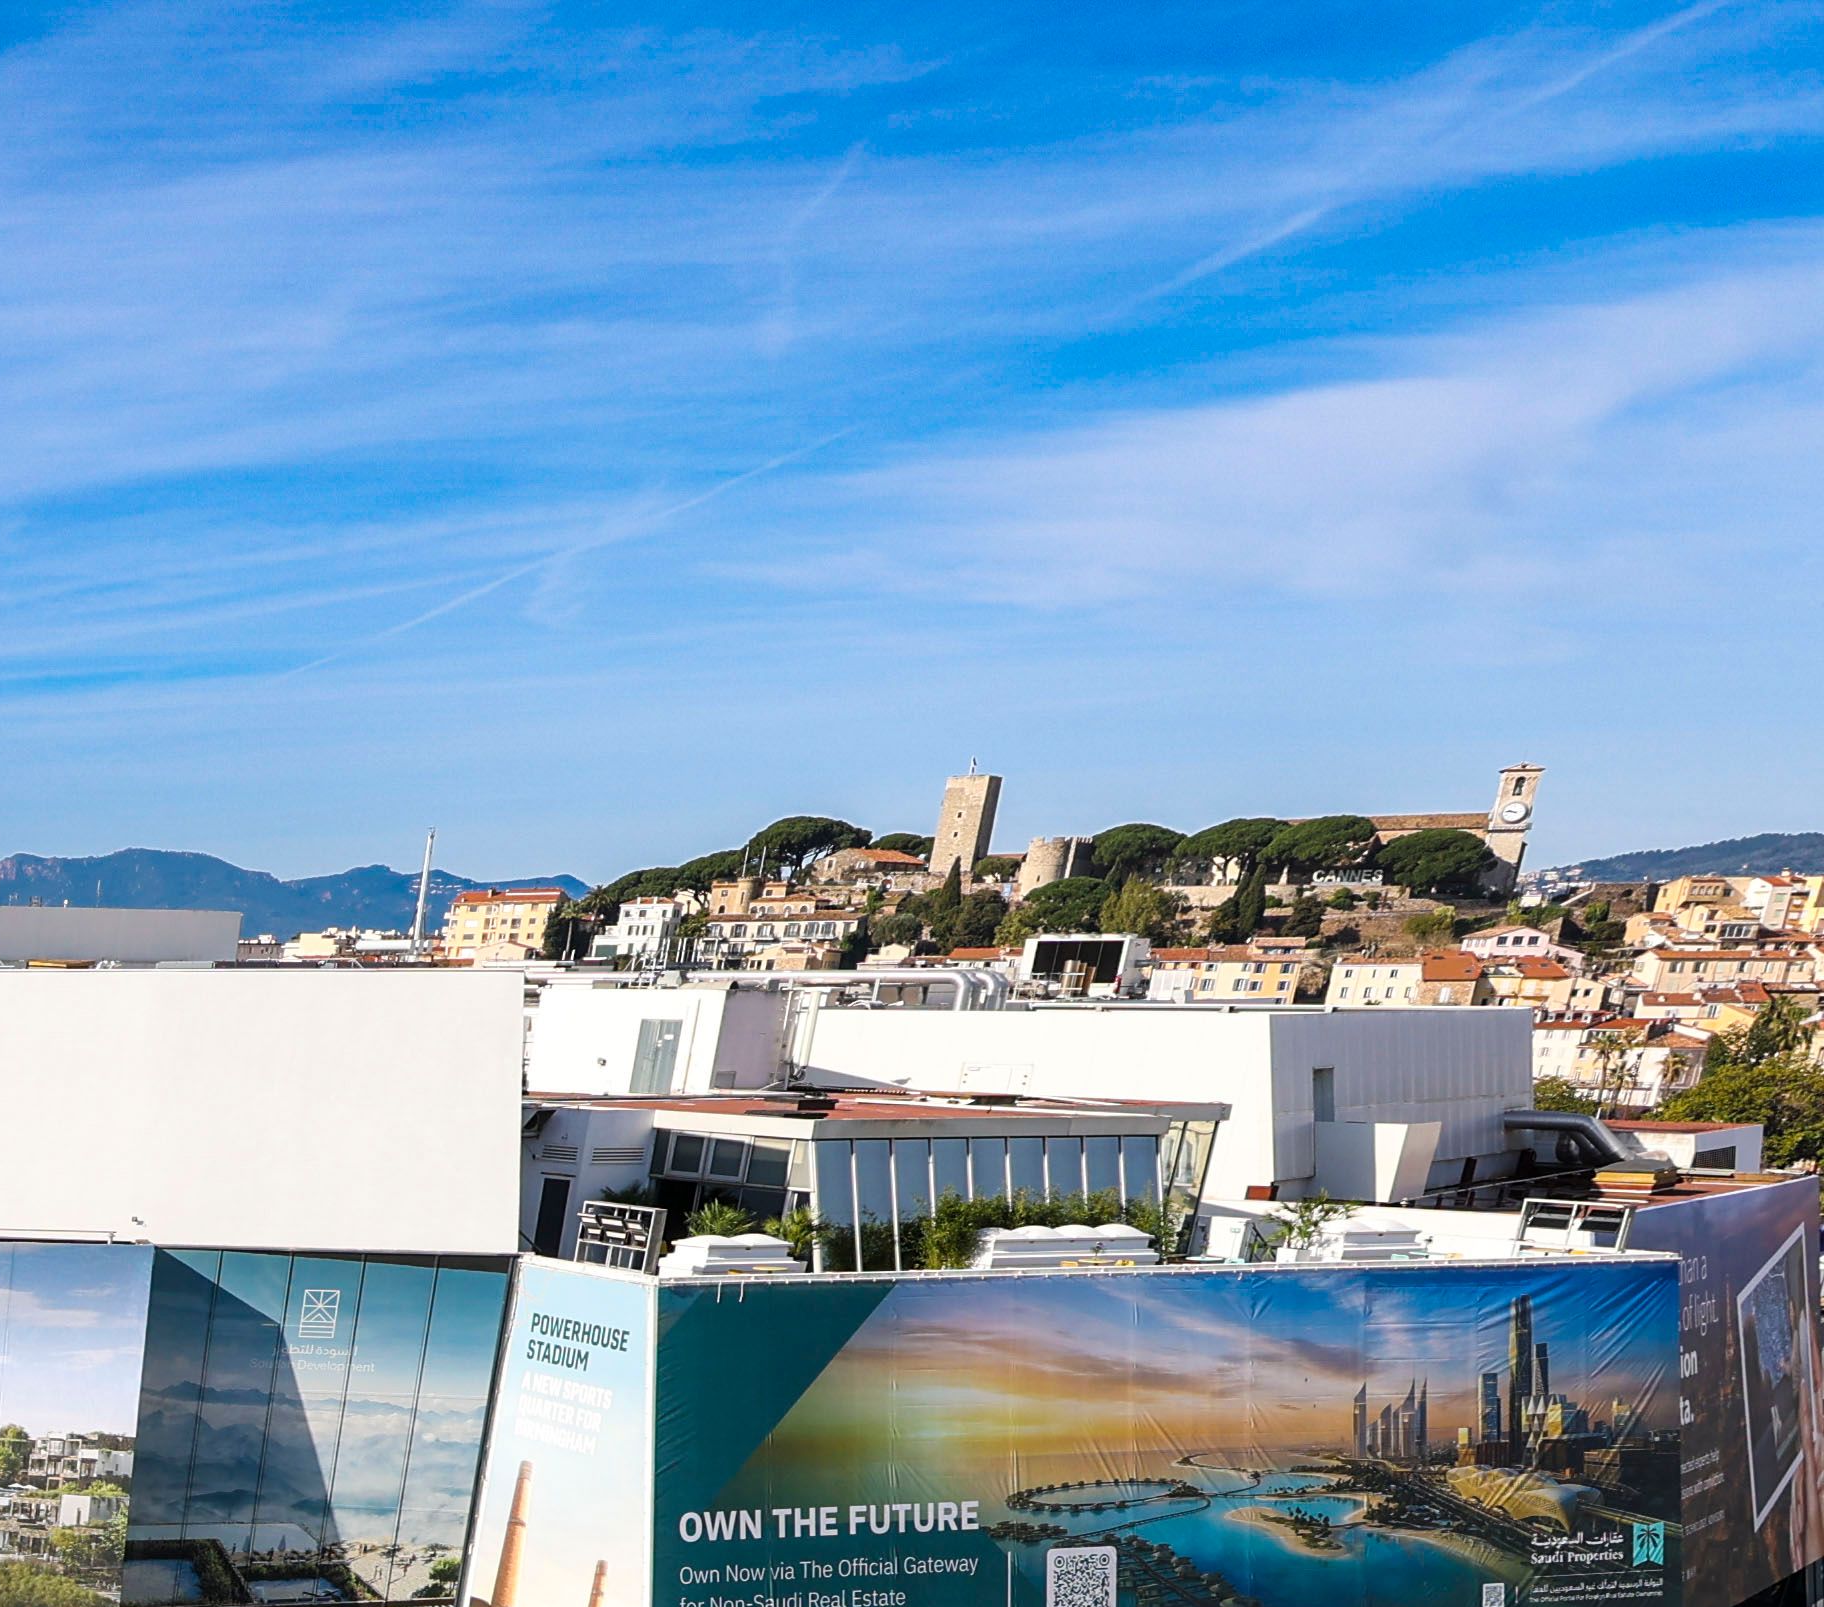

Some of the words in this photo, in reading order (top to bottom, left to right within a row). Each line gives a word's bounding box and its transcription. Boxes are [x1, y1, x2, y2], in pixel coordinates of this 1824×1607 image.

[531, 1313, 630, 1352] POWERHOUSE
[526, 1339, 589, 1371] STADIUM
[521, 1370, 531, 1390] A
[532, 1373, 563, 1396] NEW
[679, 1511, 762, 1543] OWN
[772, 1506, 838, 1539] THE
[848, 1500, 980, 1536] FUTURE
[680, 1566, 720, 1586] Own
[726, 1563, 766, 1583] Now
[770, 1560, 795, 1580] via
[800, 1558, 833, 1578] The
[839, 1555, 898, 1577] Official
[904, 1553, 979, 1580] Gateway
[1531, 1551, 1564, 1565] Saudi
[1567, 1549, 1624, 1564] Properties
[852, 1589, 906, 1607] Estate
